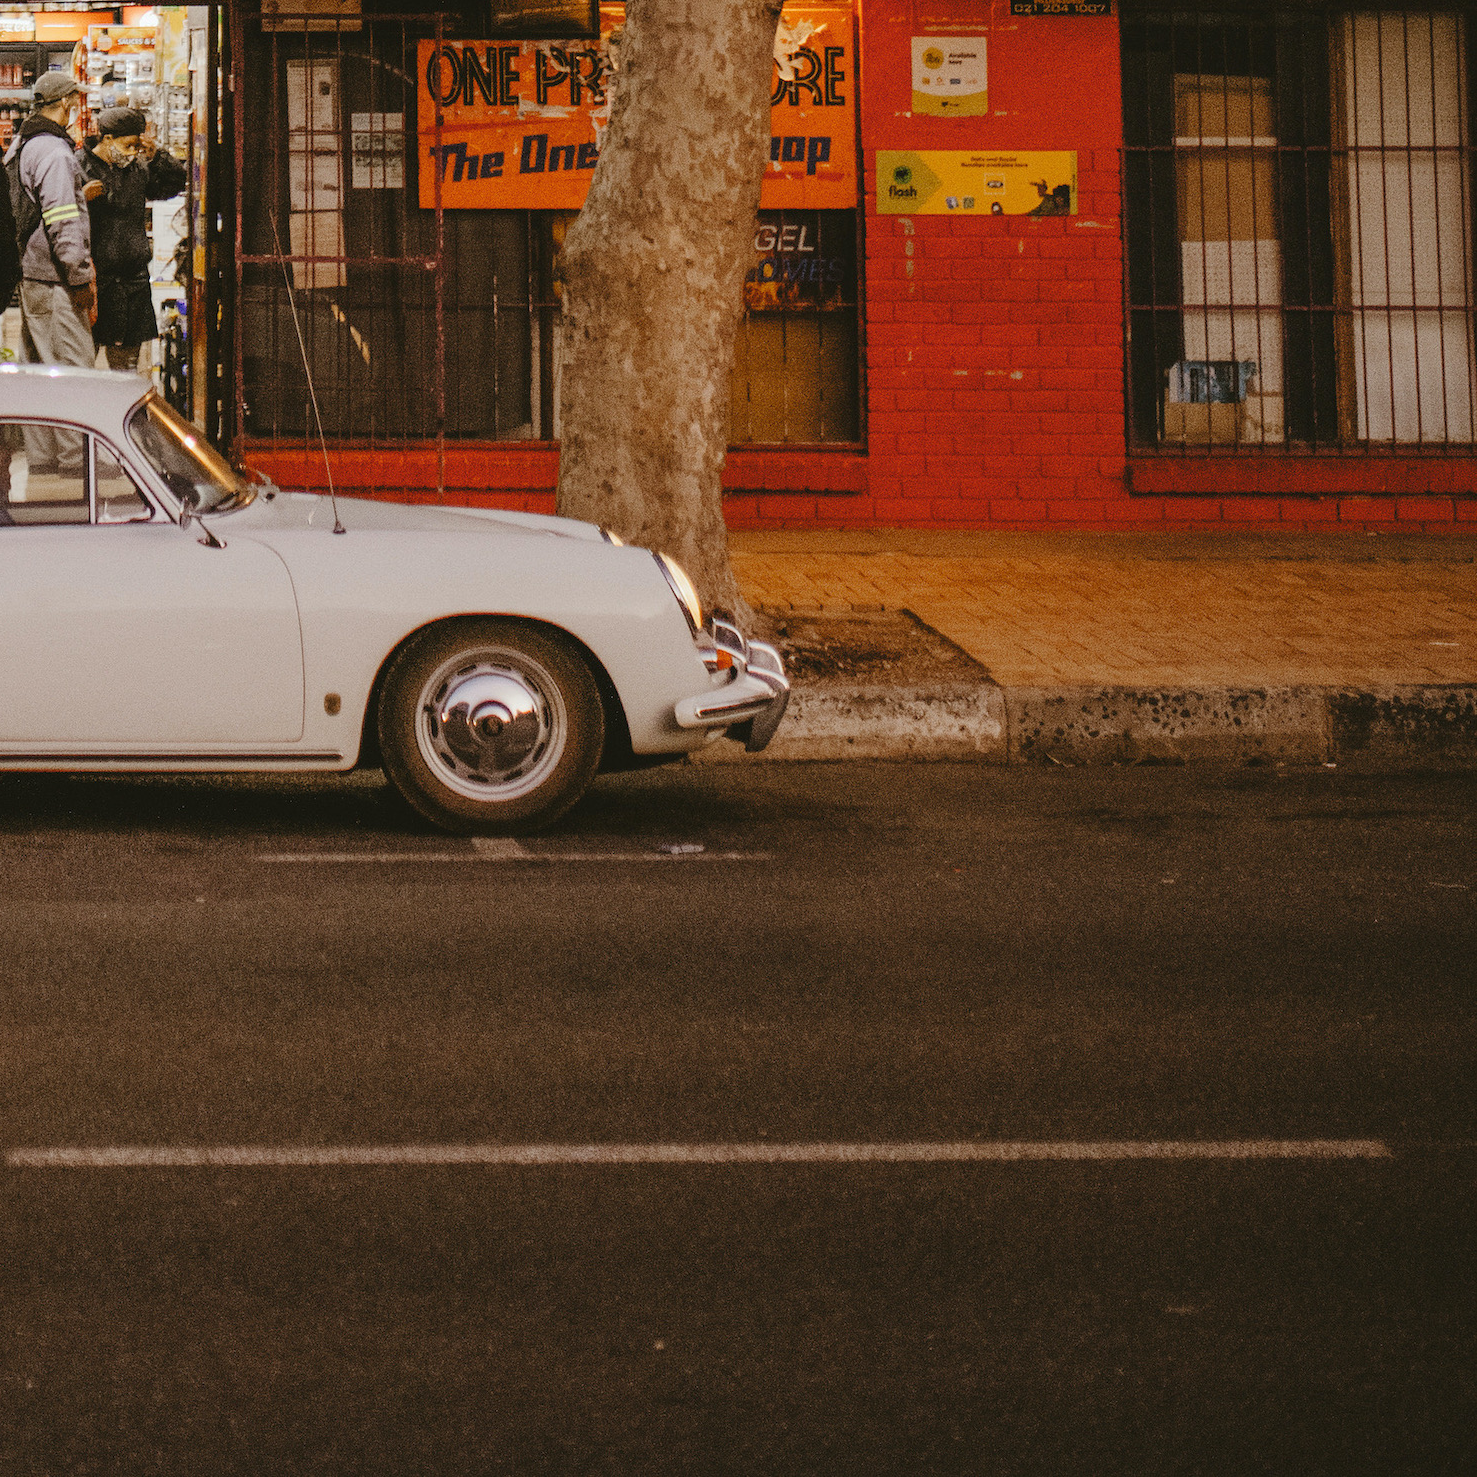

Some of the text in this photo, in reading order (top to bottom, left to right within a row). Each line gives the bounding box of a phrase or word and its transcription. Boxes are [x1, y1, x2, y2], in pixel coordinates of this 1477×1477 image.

[1014, 3, 1105, 13] 021 204 1007
[426, 46, 520, 107] ONE
[429, 142, 505, 183] The
[519, 134, 600, 175] One
[888, 185, 917, 199] flash
